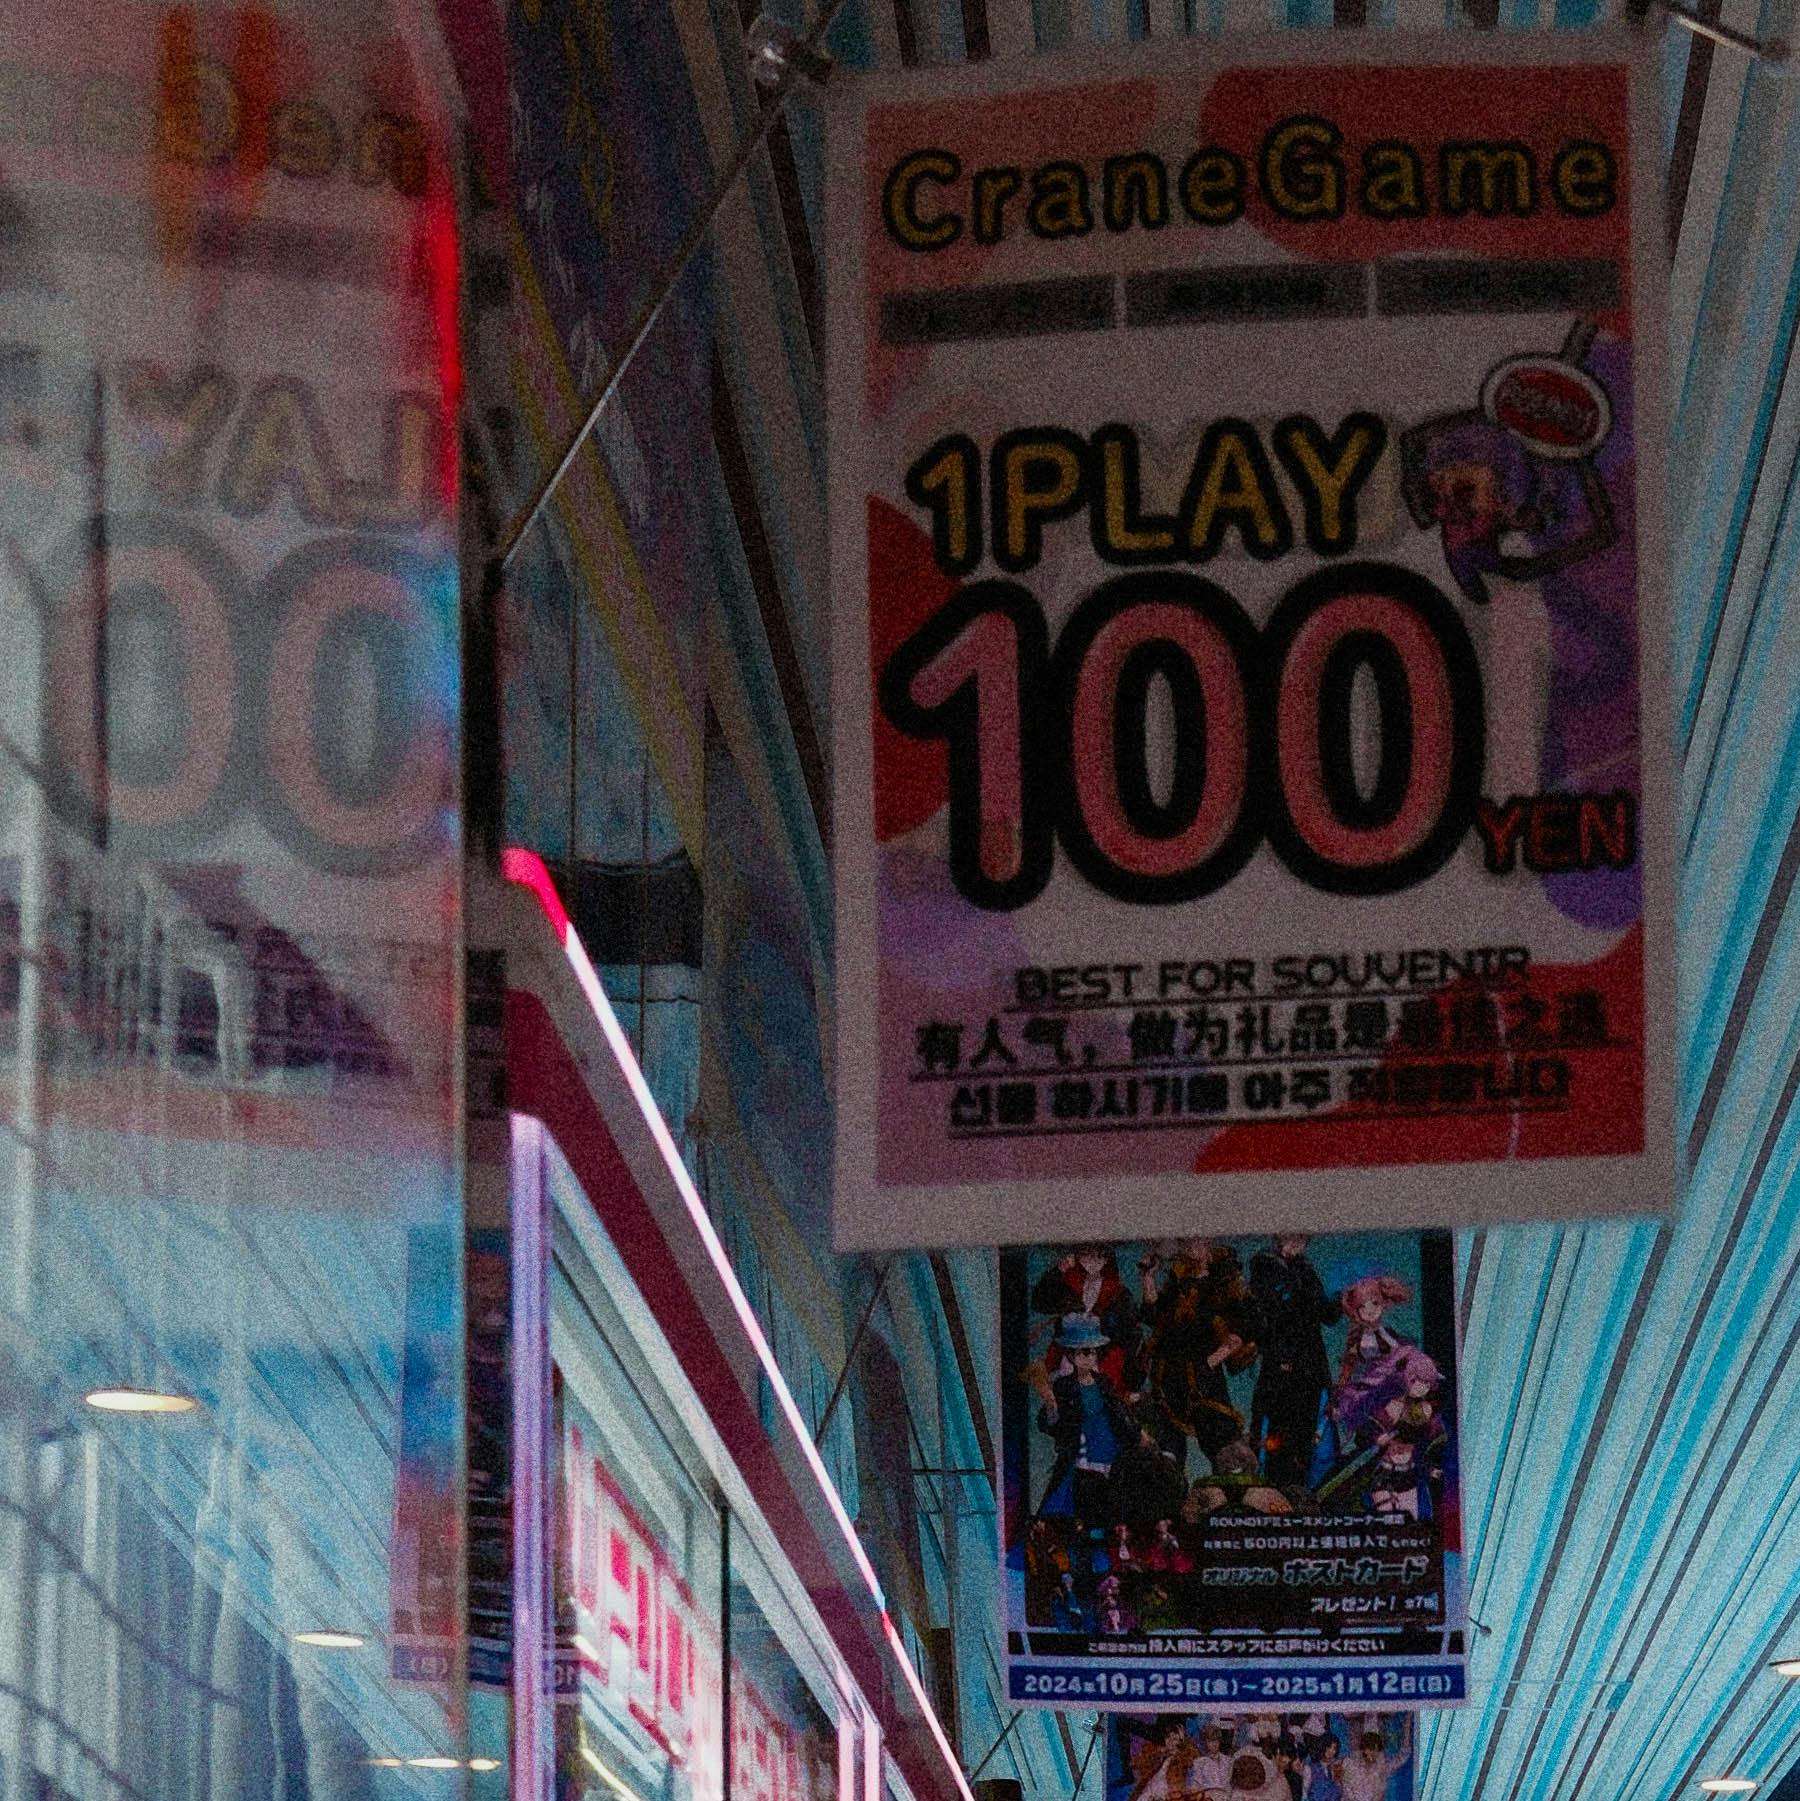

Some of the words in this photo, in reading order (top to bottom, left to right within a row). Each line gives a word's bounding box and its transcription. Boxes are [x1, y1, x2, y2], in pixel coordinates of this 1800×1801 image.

[881, 114, 1620, 252] CraneGame
[906, 412, 1388, 575] 1PLAY
[879, 561, 1484, 911] 100
[1476, 790, 1638, 875] YEN
[1016, 962, 1140, 1005] BEST
[1157, 956, 1253, 998] FOR
[1274, 945, 1533, 995] SOUVENIR
[1244, 1066, 1332, 1111] 아주
[1283, 1556, 1429, 1586] ポストカード
